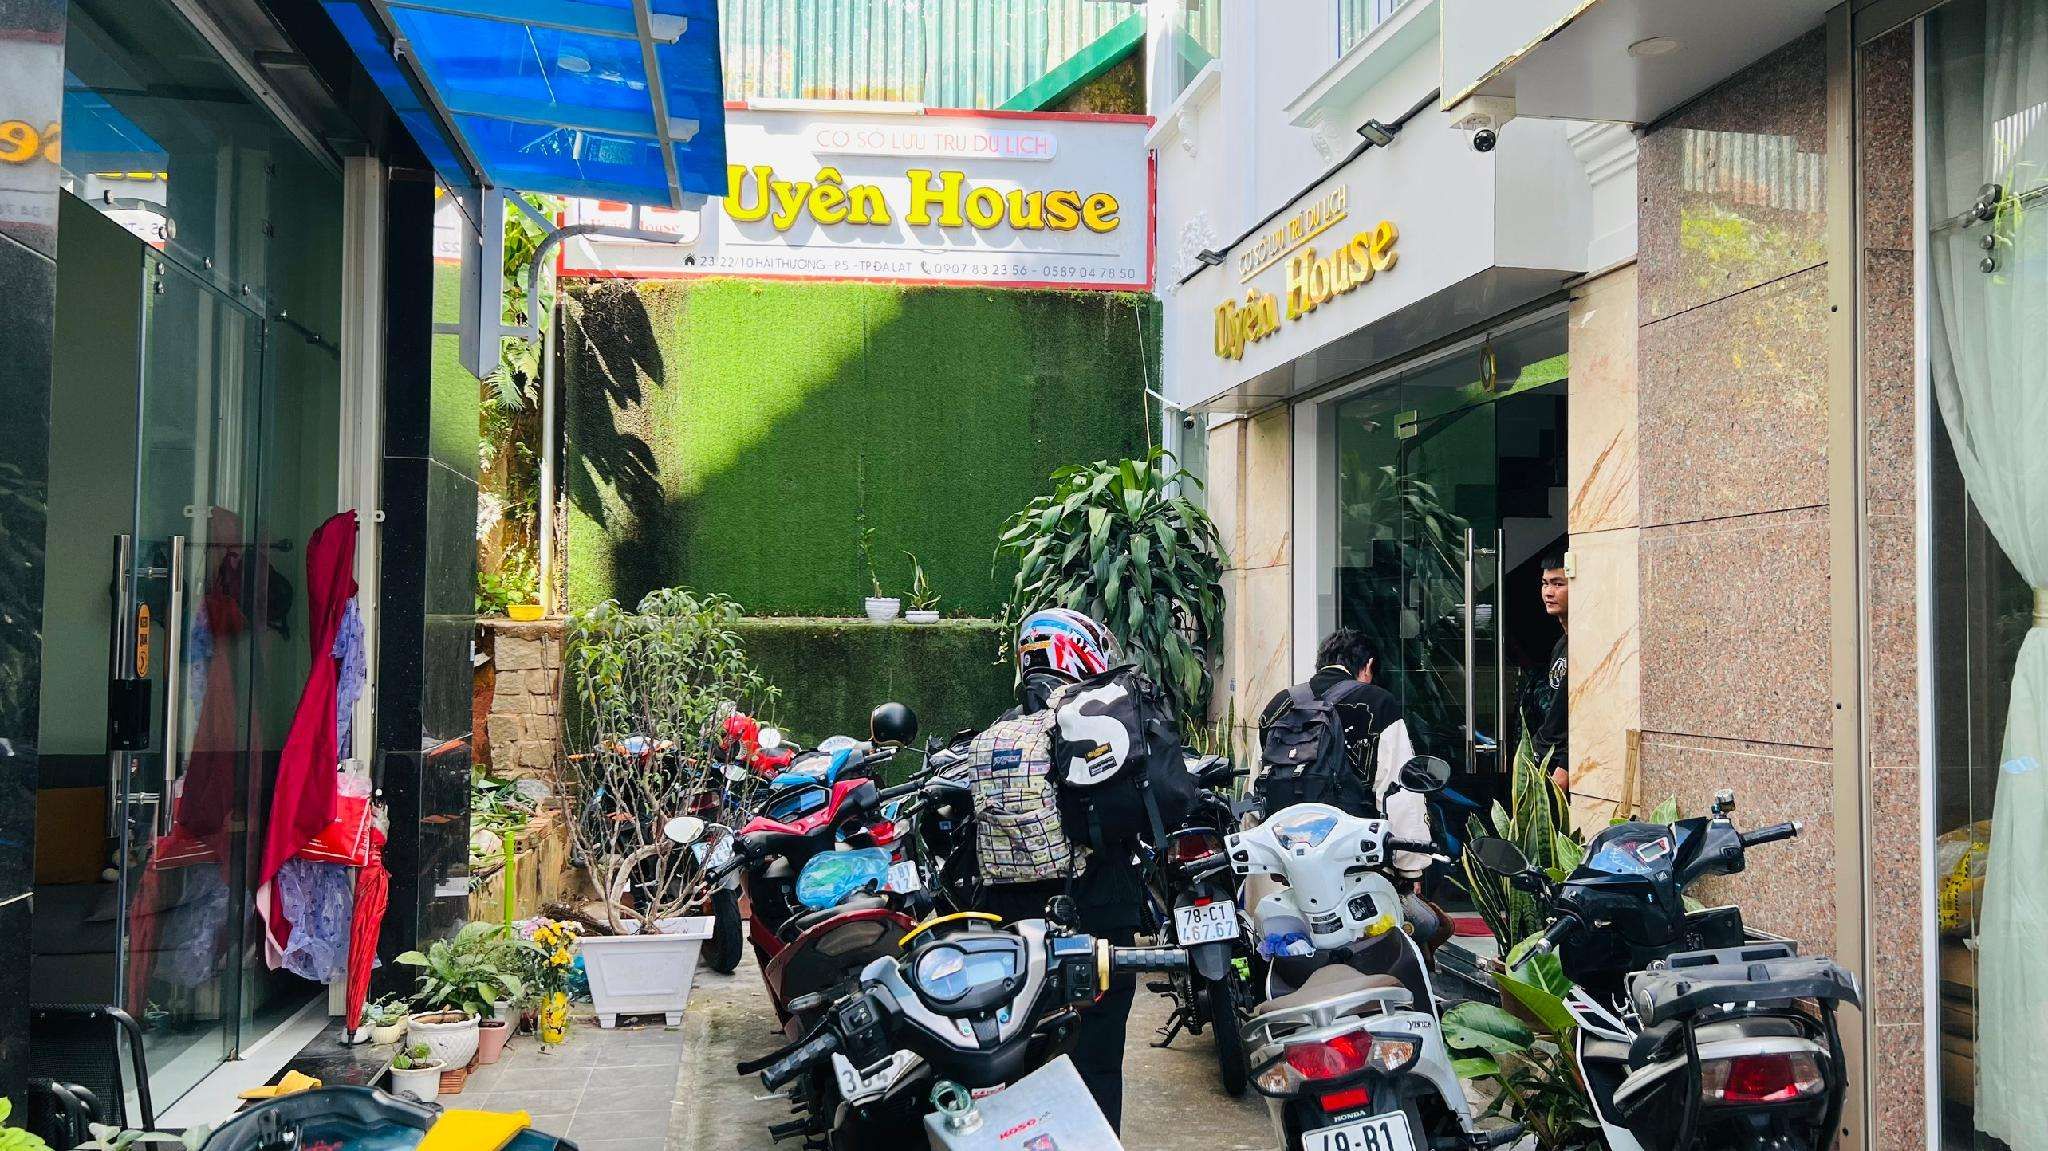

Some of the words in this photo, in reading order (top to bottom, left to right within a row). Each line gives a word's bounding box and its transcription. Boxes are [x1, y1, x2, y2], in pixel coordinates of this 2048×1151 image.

[974, 134, 999, 153] DU
[722, 164, 892, 232] Uyên
[905, 168, 1121, 233] House
[1306, 201, 1321, 232] DU
[934, 263, 967, 275] 0907
[972, 264, 988, 275] 83
[992, 264, 1007, 276] 23
[1012, 265, 1028, 276] 56
[1043, 265, 1076, 278] 0589
[1080, 266, 1096, 278] 04
[1119, 267, 1135, 280] 50
[1214, 287, 1281, 361] Uyên
[1285, 219, 1399, 322] House
[1184, 904, 1226, 926] 78-C1
[1334, 1110, 1366, 1123] HONDA
